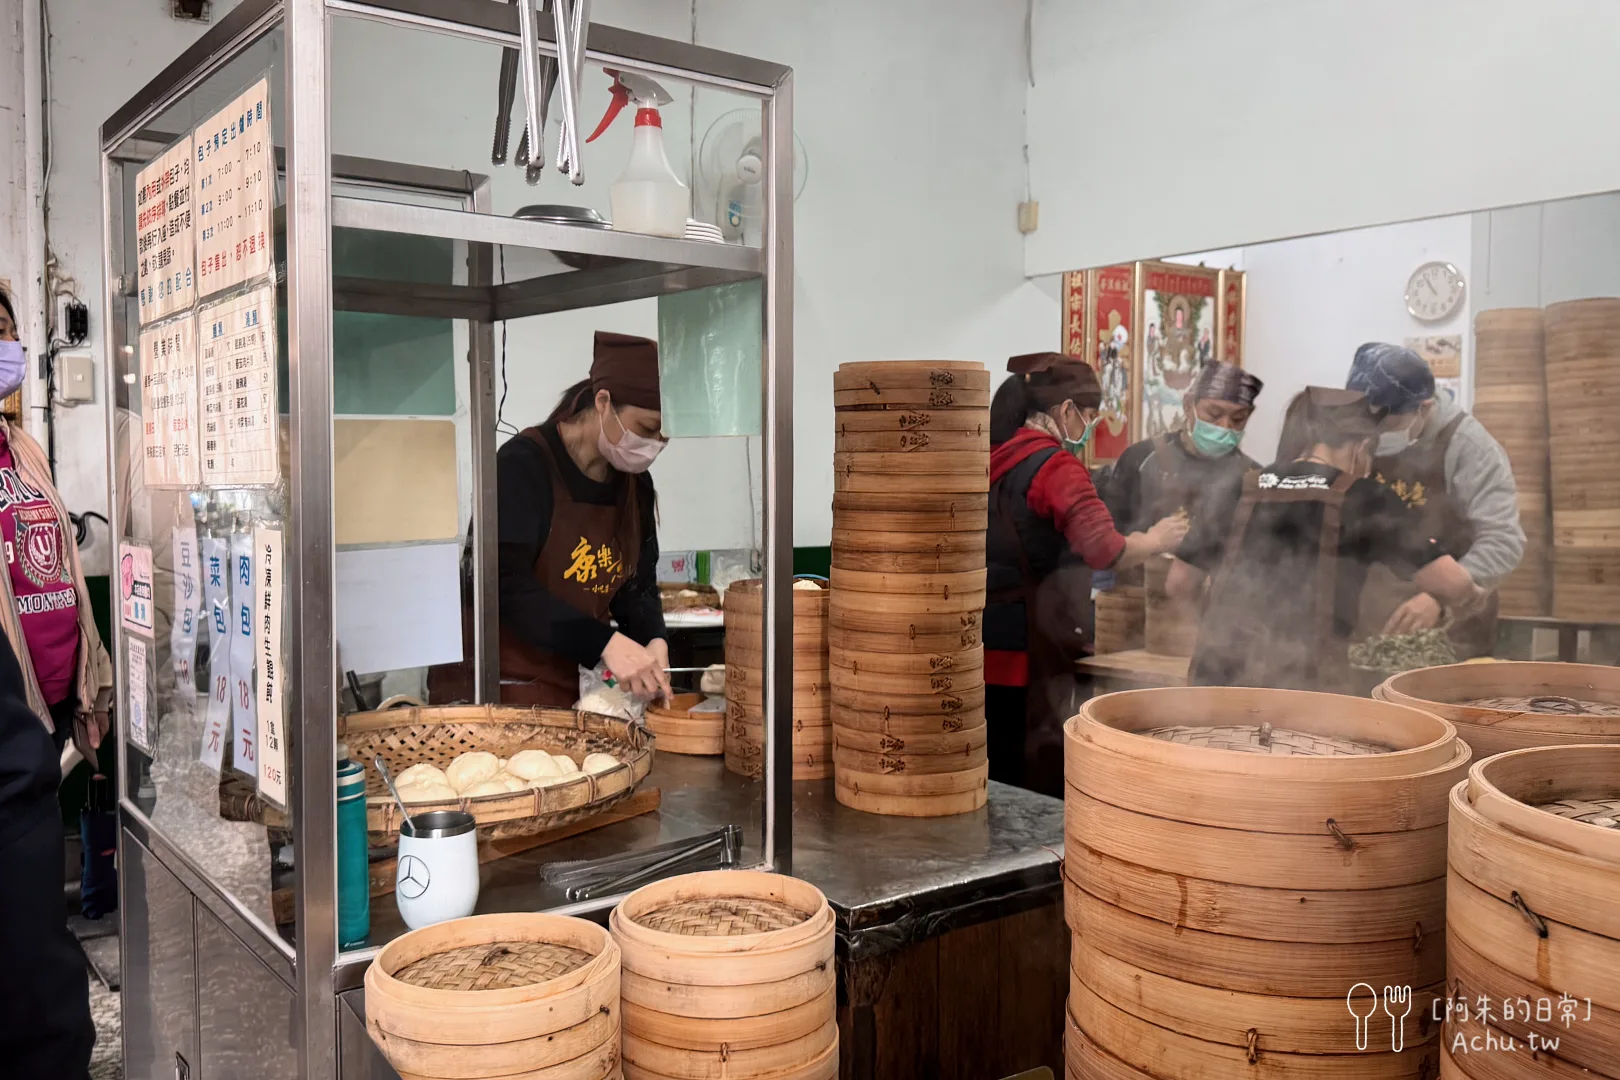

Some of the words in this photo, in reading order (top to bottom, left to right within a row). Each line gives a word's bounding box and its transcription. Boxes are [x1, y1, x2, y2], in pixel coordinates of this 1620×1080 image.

[217, 160, 232, 180] 7:00
[245, 140, 260, 160] 7:10
[218, 187, 232, 206] 9:00
[245, 169, 261, 189] 9:10
[217, 215, 232, 233] 11:00
[244, 198, 262, 218] 11:10
[36, 535, 51, 555] U
[178, 541, 194, 635] 豆沙包
[209, 555, 227, 634] 菜包
[238, 554, 252, 637] 肉包
